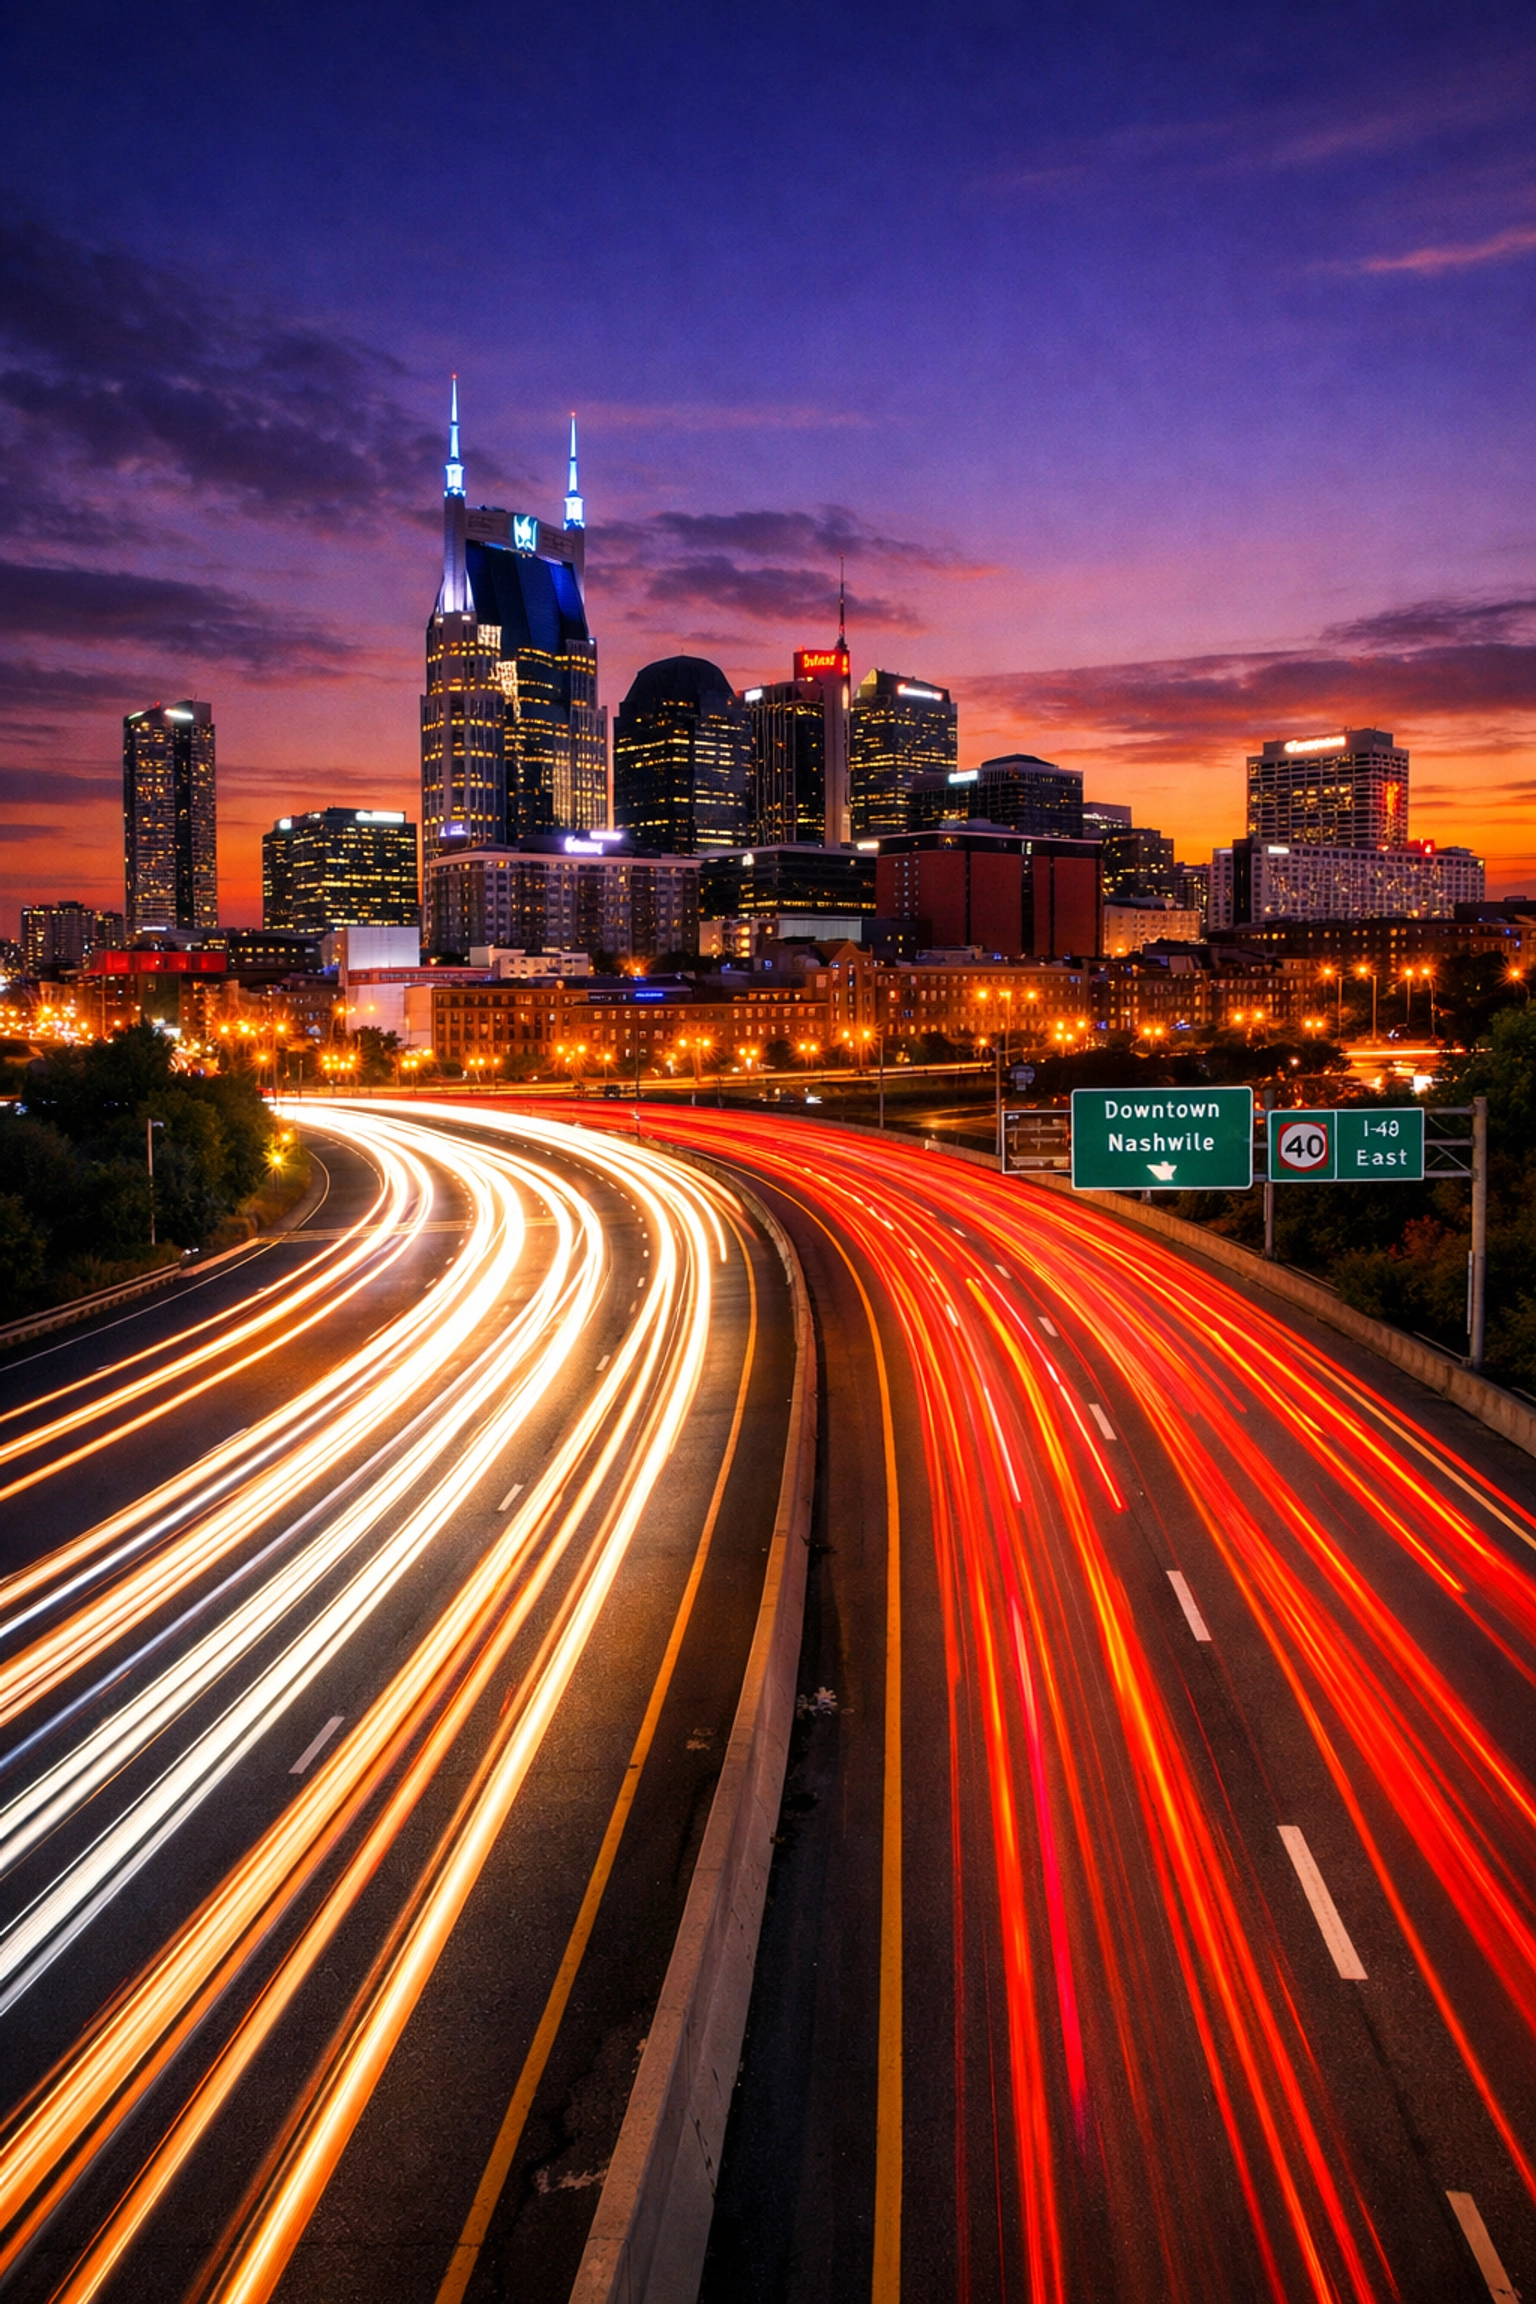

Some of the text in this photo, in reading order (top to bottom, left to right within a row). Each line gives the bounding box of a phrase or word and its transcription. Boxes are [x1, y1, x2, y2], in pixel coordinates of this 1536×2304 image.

[1105, 1100, 1220, 1119] Downtown
[1108, 1132, 1215, 1152] Nashwile
[1284, 1134, 1325, 1159] 40
[1357, 1148, 1407, 1166] East
